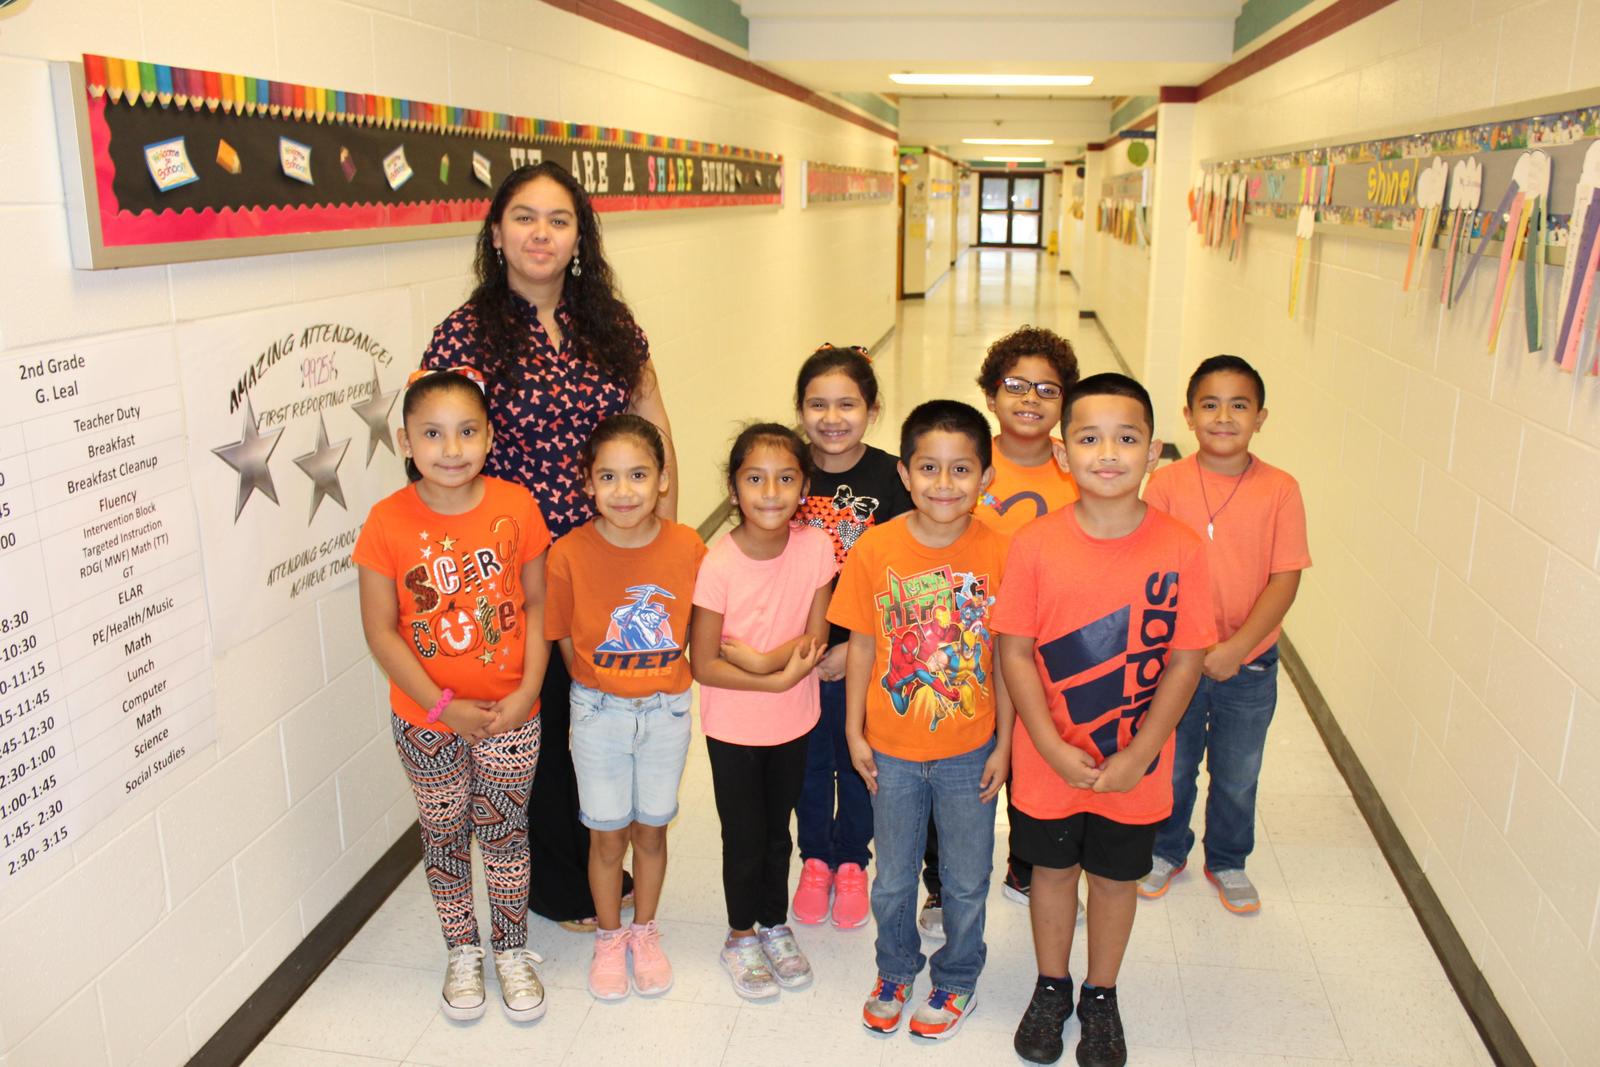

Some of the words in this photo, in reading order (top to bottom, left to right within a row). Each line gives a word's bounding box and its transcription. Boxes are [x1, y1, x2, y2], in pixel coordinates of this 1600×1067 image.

[623, 152, 635, 192] A
[19, 361, 45, 381] 2nd
[47, 353, 86, 375] Grade
[229, 333, 295, 415] AMAZING
[300, 323, 393, 369] ATTENDANCE!
[35, 388, 50, 404] G.
[53, 380, 79, 401] Leal
[257, 404, 292, 430] FIRST
[291, 391, 345, 419] REPORTING
[347, 378, 379, 402] PERIOD
[74, 410, 115, 433] Teacher
[116, 405, 141, 421] Duty
[88, 433, 136, 458] Breakfast
[67, 467, 118, 495] Breakfast
[119, 455, 158, 478] Cleanup
[99, 489, 138, 512] Fluency
[83, 513, 135, 539] Intervention
[136, 502, 157, 519] Block
[82, 534, 119, 559] Targeted
[120, 519, 163, 544] Instruction
[131, 540, 152, 558] Math
[153, 532, 169, 550] (TT)
[266, 546, 318, 587] ATTENDING
[319, 528, 357, 558] SCHOOL
[122, 565, 135, 579] GT
[290, 565, 327, 599] ACHIEVE
[329, 554, 355, 577] TOMO
[118, 584, 144, 605] ELAR
[92, 597, 175, 646] PE/Health/Music
[124, 632, 152, 656] Math
[127, 659, 155, 683] Lunch
[592, 649, 683, 670] UTEP
[122, 678, 168, 713] Computer
[136, 703, 162, 730] Math
[134, 727, 170, 759] Science
[125, 766, 152, 794] Social
[153, 745, 186, 774] Studies
[37, 799, 63, 826] 2:30
[42, 825, 69, 853] 3:15
